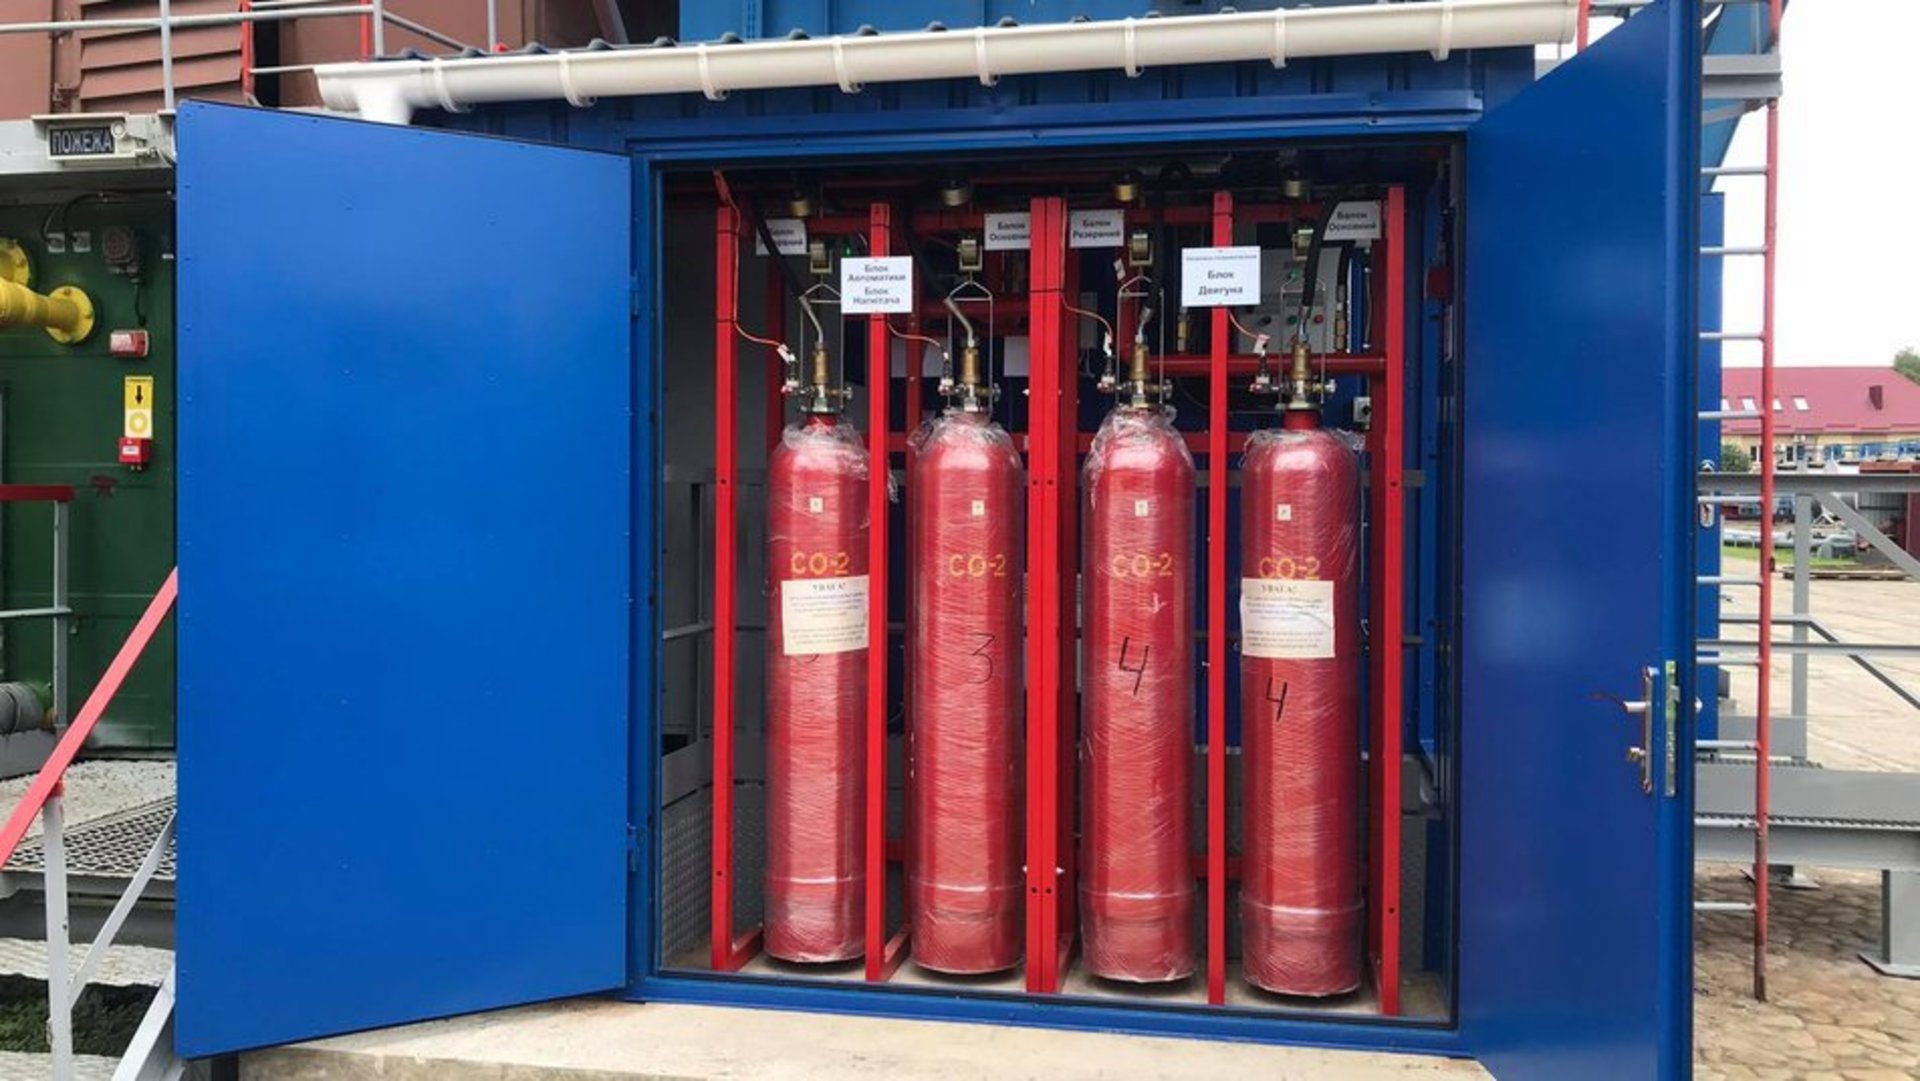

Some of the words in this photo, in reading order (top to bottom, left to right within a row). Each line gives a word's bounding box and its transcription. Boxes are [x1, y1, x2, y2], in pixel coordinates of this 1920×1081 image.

[52, 130, 112, 153] ПОЖЕЖА
[1337, 210, 1368, 220] Балон
[997, 221, 1025, 230] Балон
[1082, 219, 1112, 228] Балон
[1328, 222, 1377, 232] Основний
[1072, 230, 1121, 240] Резервний
[864, 263, 889, 273] Блок
[847, 274, 906, 283] Автоматики
[1207, 269, 1234, 280] Блок
[864, 286, 889, 296] Блок
[1197, 285, 1244, 297] Двигуна
[790, 552, 849, 576] CO-2
[948, 553, 1007, 577] CO-2
[1111, 552, 1173, 578] CO-2
[1258, 556, 1321, 579] CO-2
[967, 632, 996, 684] 3
[1118, 635, 1150, 696] 4
[1265, 676, 1288, 722] 4
